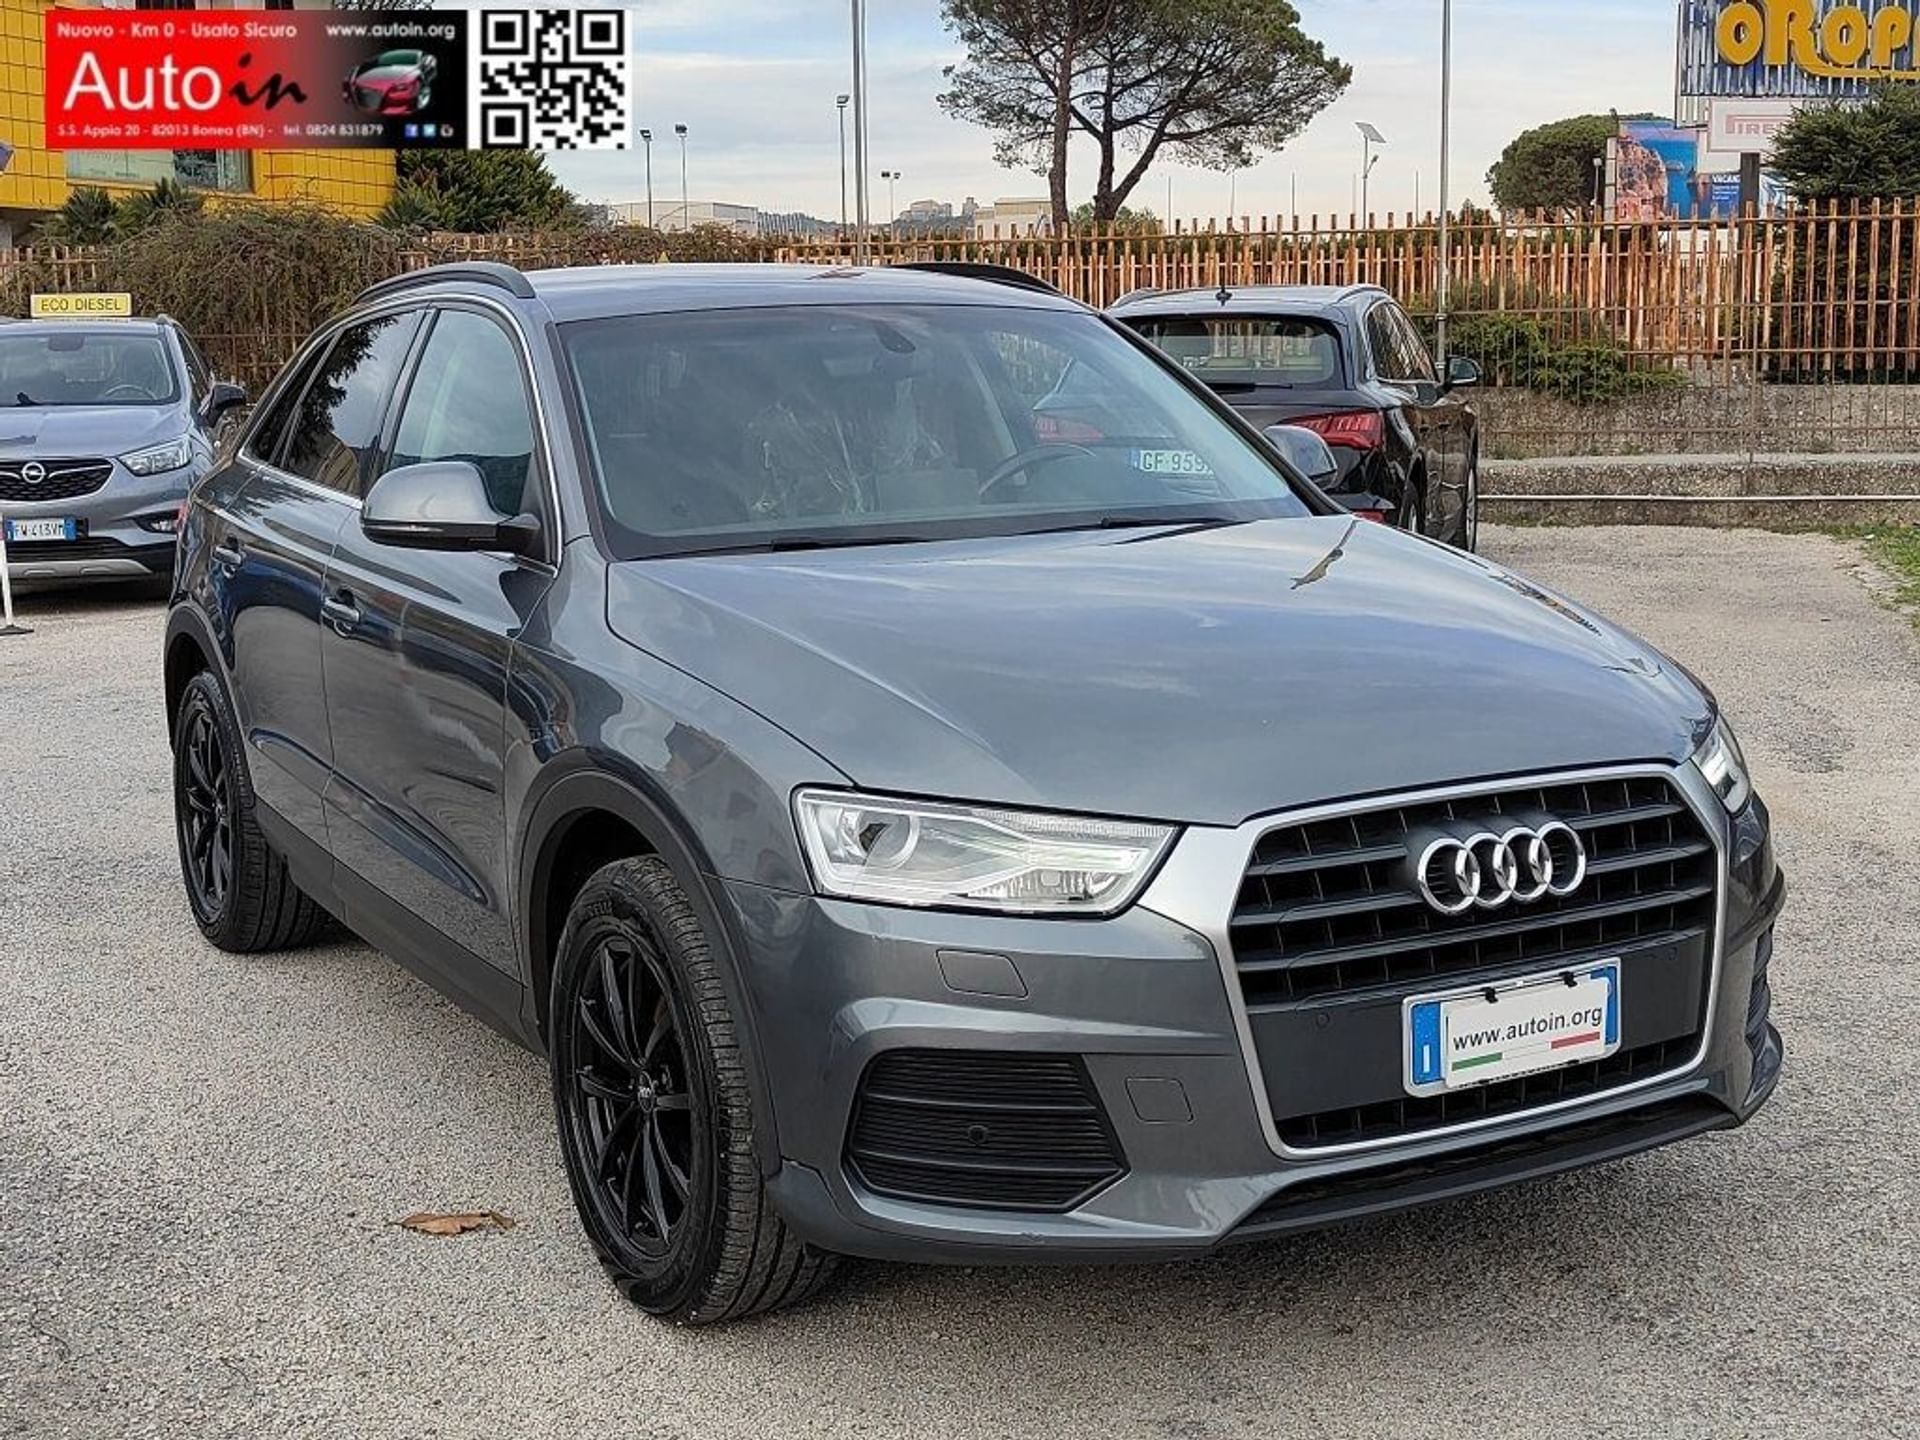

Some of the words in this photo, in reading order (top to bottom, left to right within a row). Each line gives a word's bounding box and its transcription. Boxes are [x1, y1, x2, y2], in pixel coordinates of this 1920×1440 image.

[41, 298, 69, 311] ECO
[75, 298, 122, 311] DIESEL
[1453, 1006, 1602, 1051] www.autoin.org
